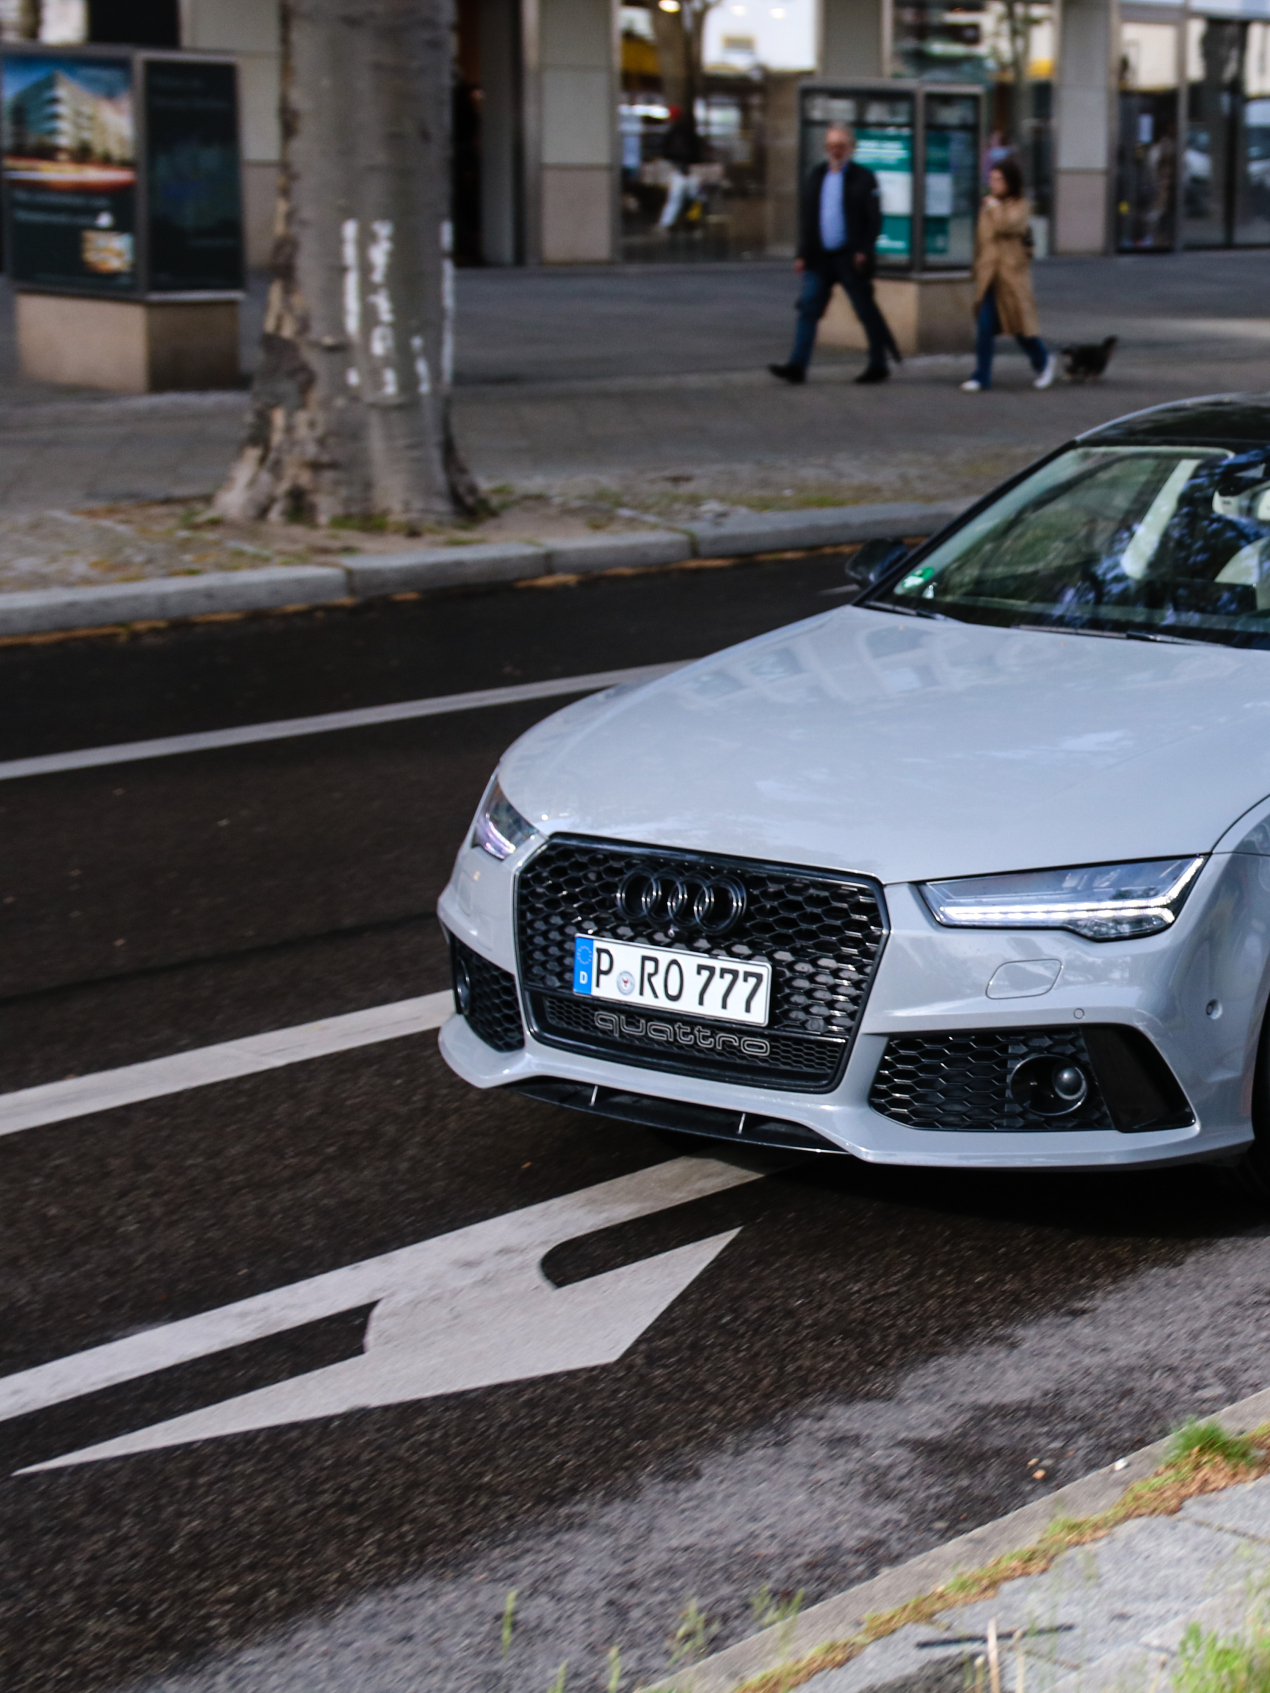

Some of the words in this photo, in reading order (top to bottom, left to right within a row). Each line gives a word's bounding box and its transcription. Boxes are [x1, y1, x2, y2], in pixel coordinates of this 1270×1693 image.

[578, 970, 588, 985] D
[595, 947, 614, 988] P
[639, 955, 684, 1002] RO
[696, 963, 764, 1014] 777
[593, 1010, 771, 1057] quattro
